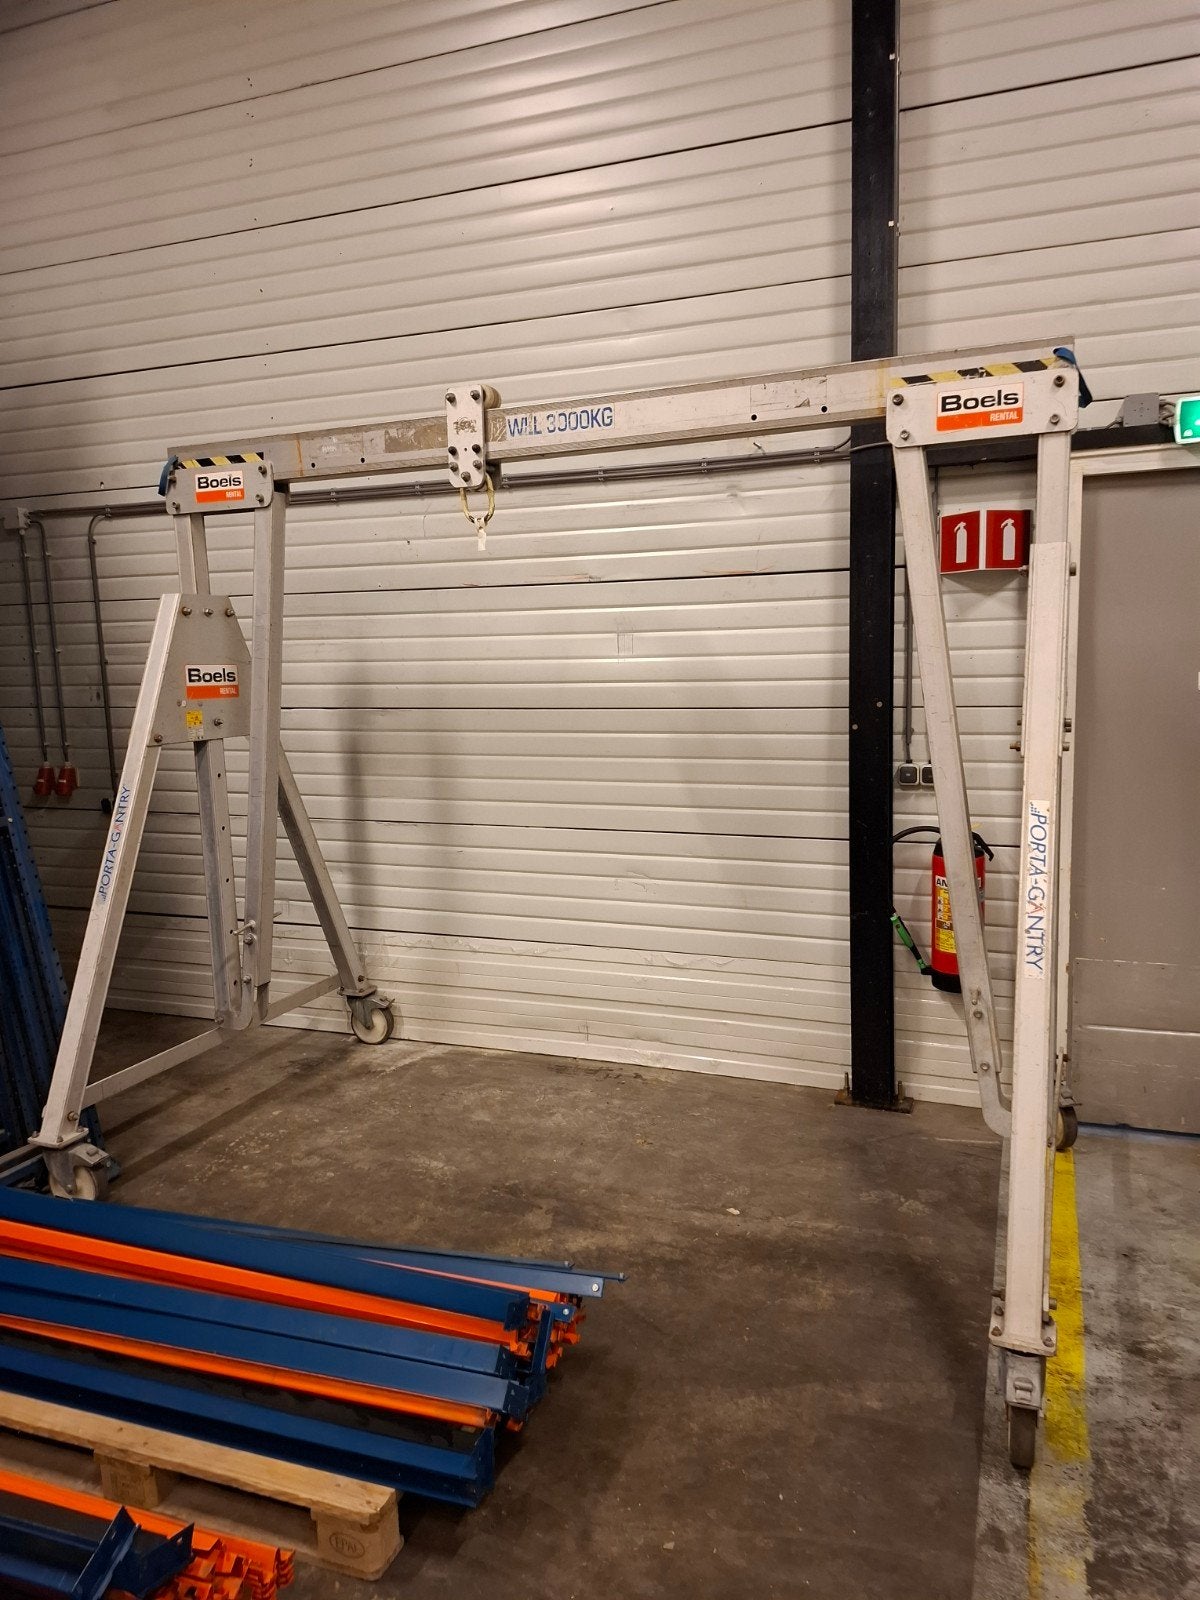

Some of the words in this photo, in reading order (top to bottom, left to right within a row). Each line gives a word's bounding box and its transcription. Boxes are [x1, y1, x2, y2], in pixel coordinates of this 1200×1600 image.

[941, 389, 1019, 413] Boels
[546, 406, 614, 434] 3000KG
[989, 410, 1019, 422] RENTAL
[197, 474, 242, 489] Boels
[187, 667, 236, 683] Boels
[219, 687, 237, 695] RENTAL
[98, 785, 131, 895] PORTA-GANTRY
[1024, 812, 1048, 971] PORTA-GANTRY
